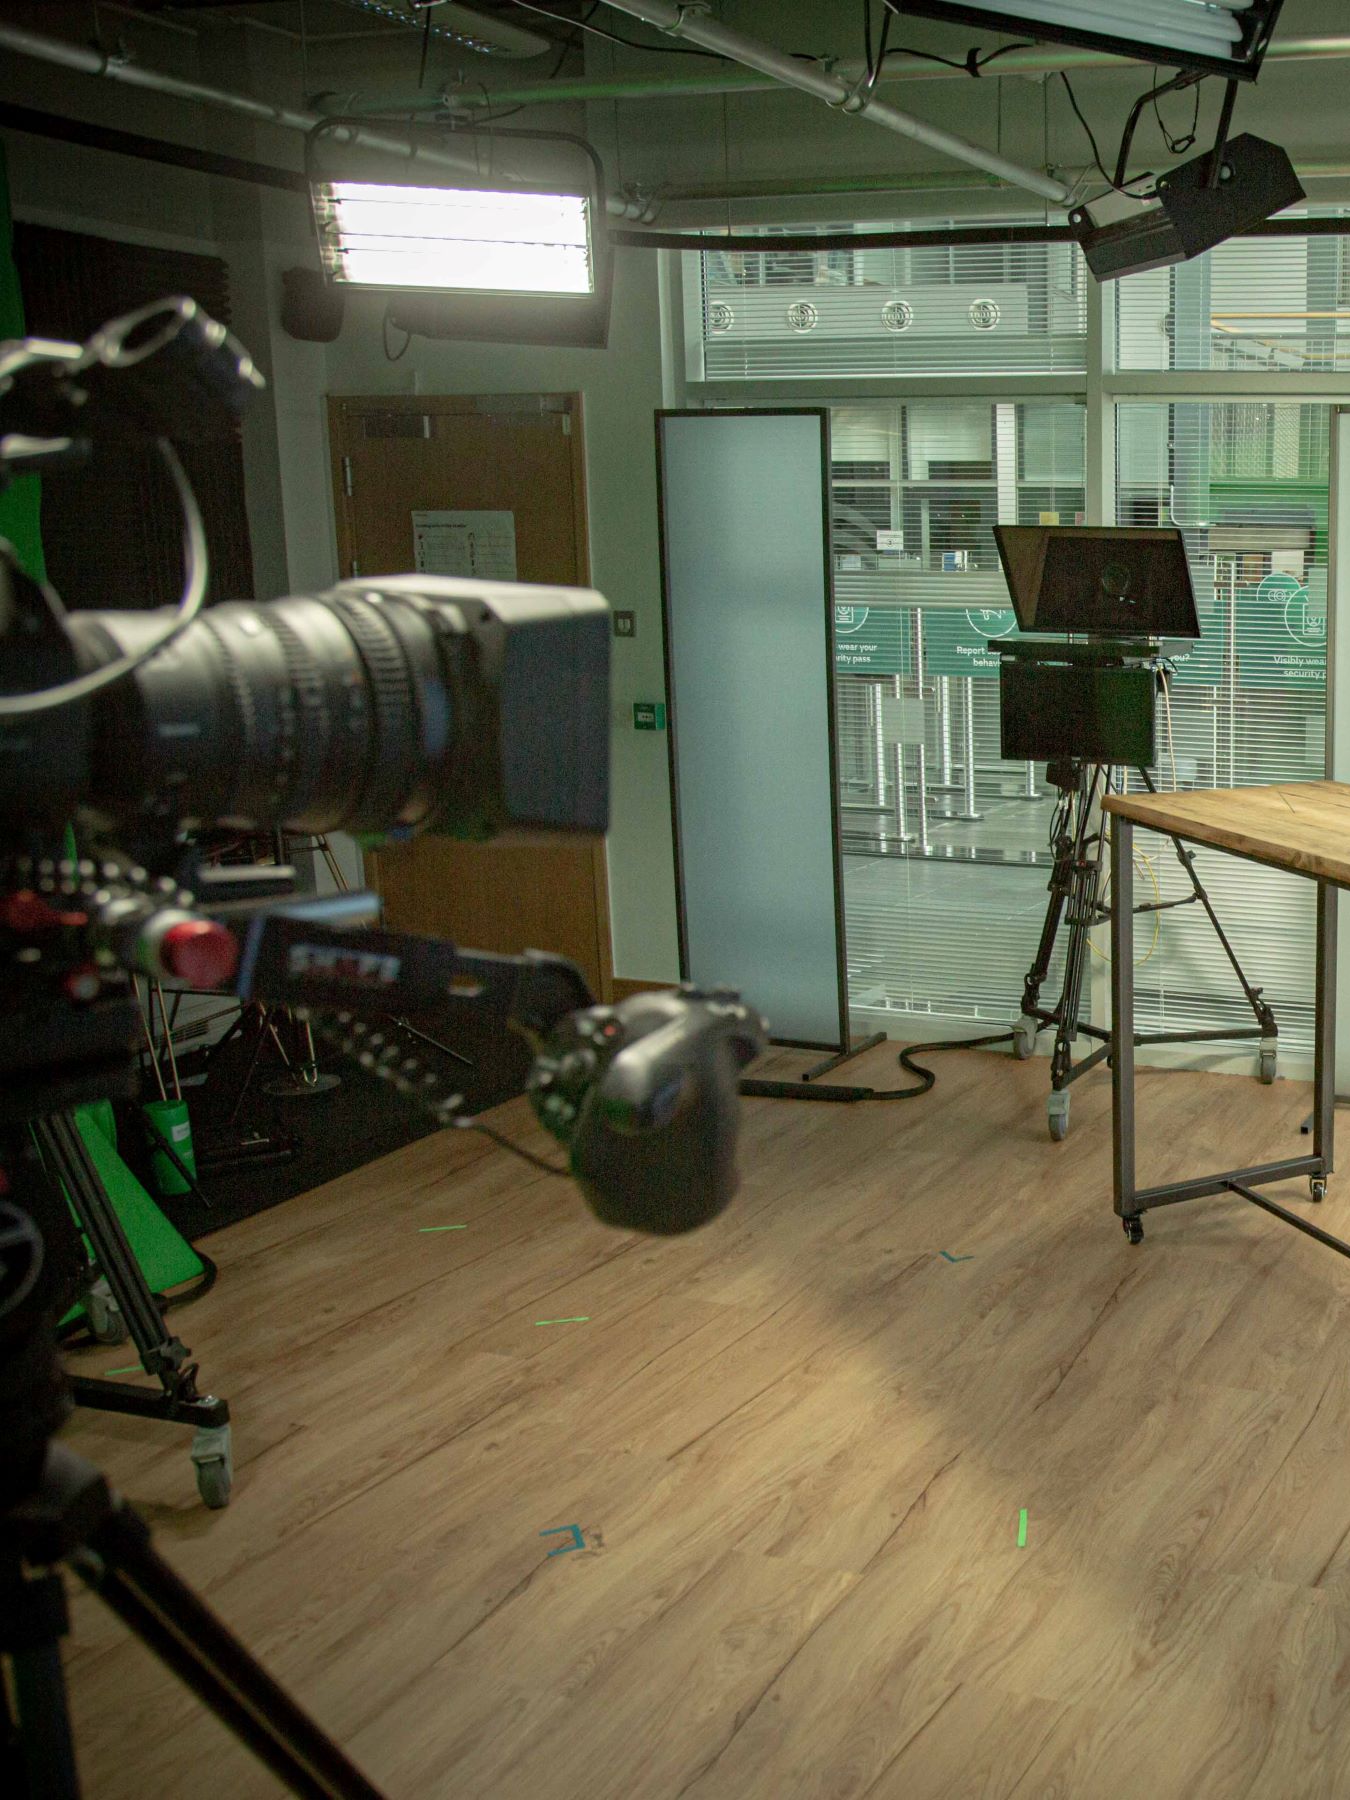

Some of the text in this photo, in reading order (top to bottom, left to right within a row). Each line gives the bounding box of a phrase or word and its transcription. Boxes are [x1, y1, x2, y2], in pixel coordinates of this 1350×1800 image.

[859, 644, 878, 653] your
[956, 646, 986, 656] Report
[852, 655, 871, 664] pass
[1273, 655, 1304, 667] Visibly
[1283, 670, 1321, 680] security
